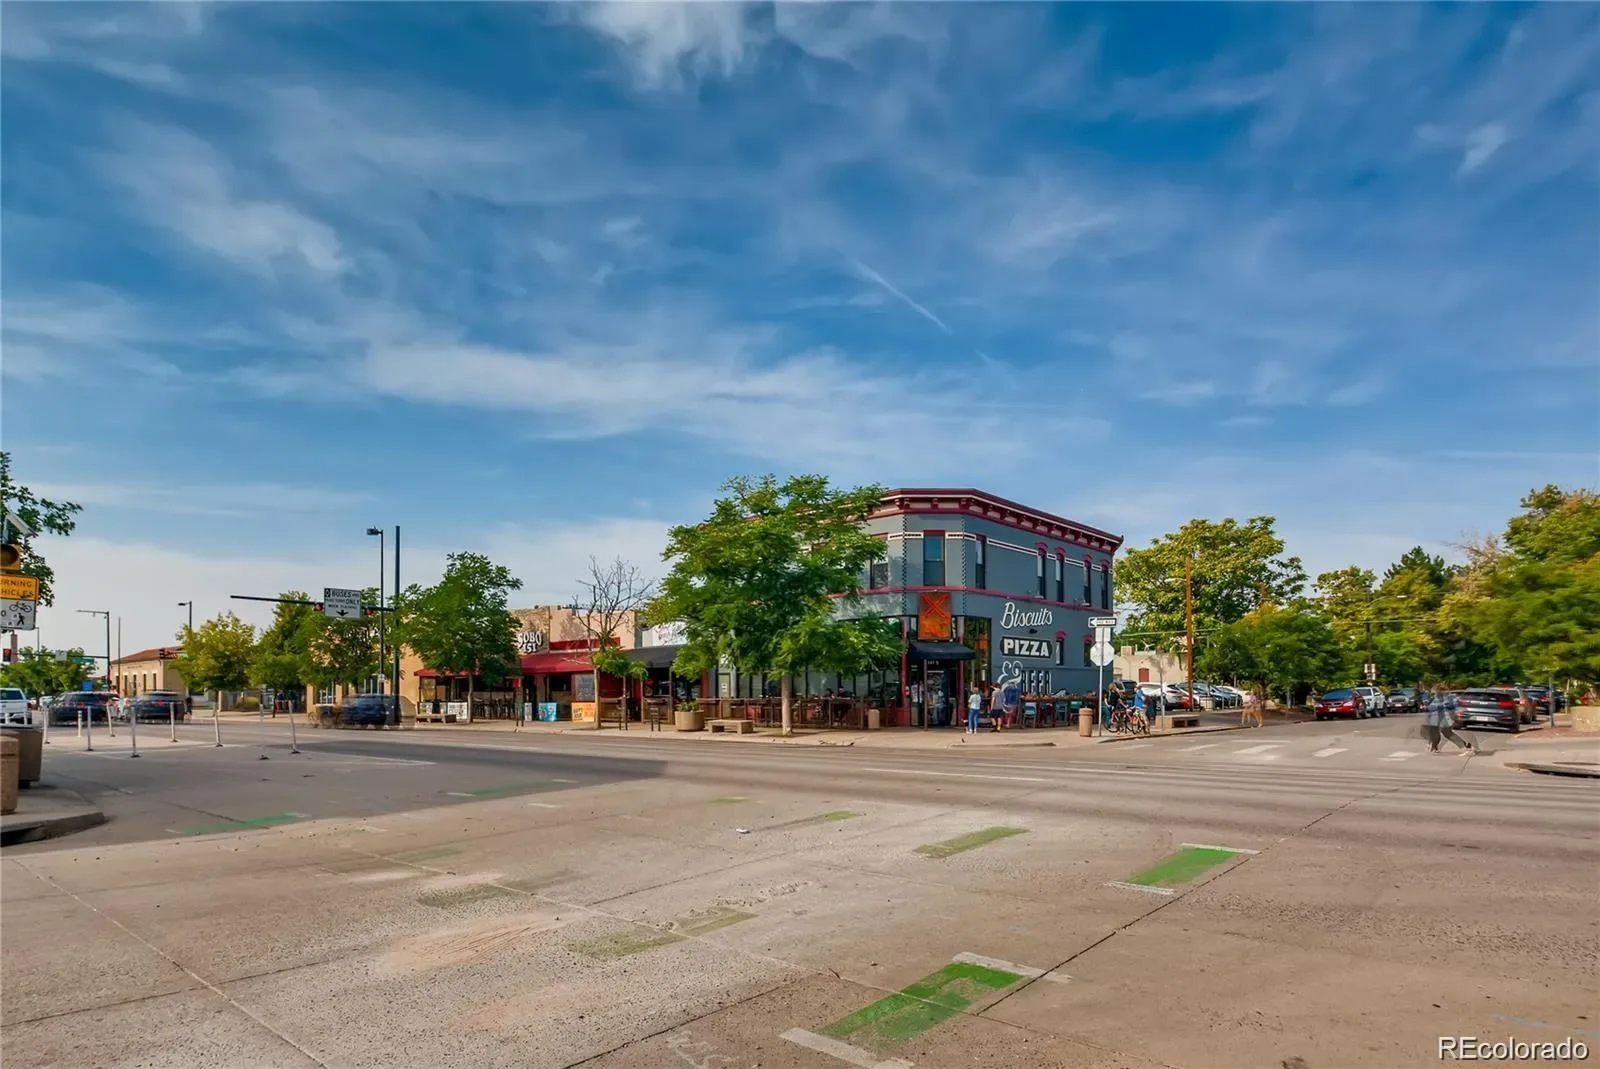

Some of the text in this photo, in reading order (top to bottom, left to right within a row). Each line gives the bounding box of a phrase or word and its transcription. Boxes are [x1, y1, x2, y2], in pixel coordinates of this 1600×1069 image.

[1, 588, 34, 597] HICLES
[1000, 602, 1053, 629] Biscuits
[517, 631, 542, 648] SOBO
[1003, 638, 1050, 657] PIZZA
